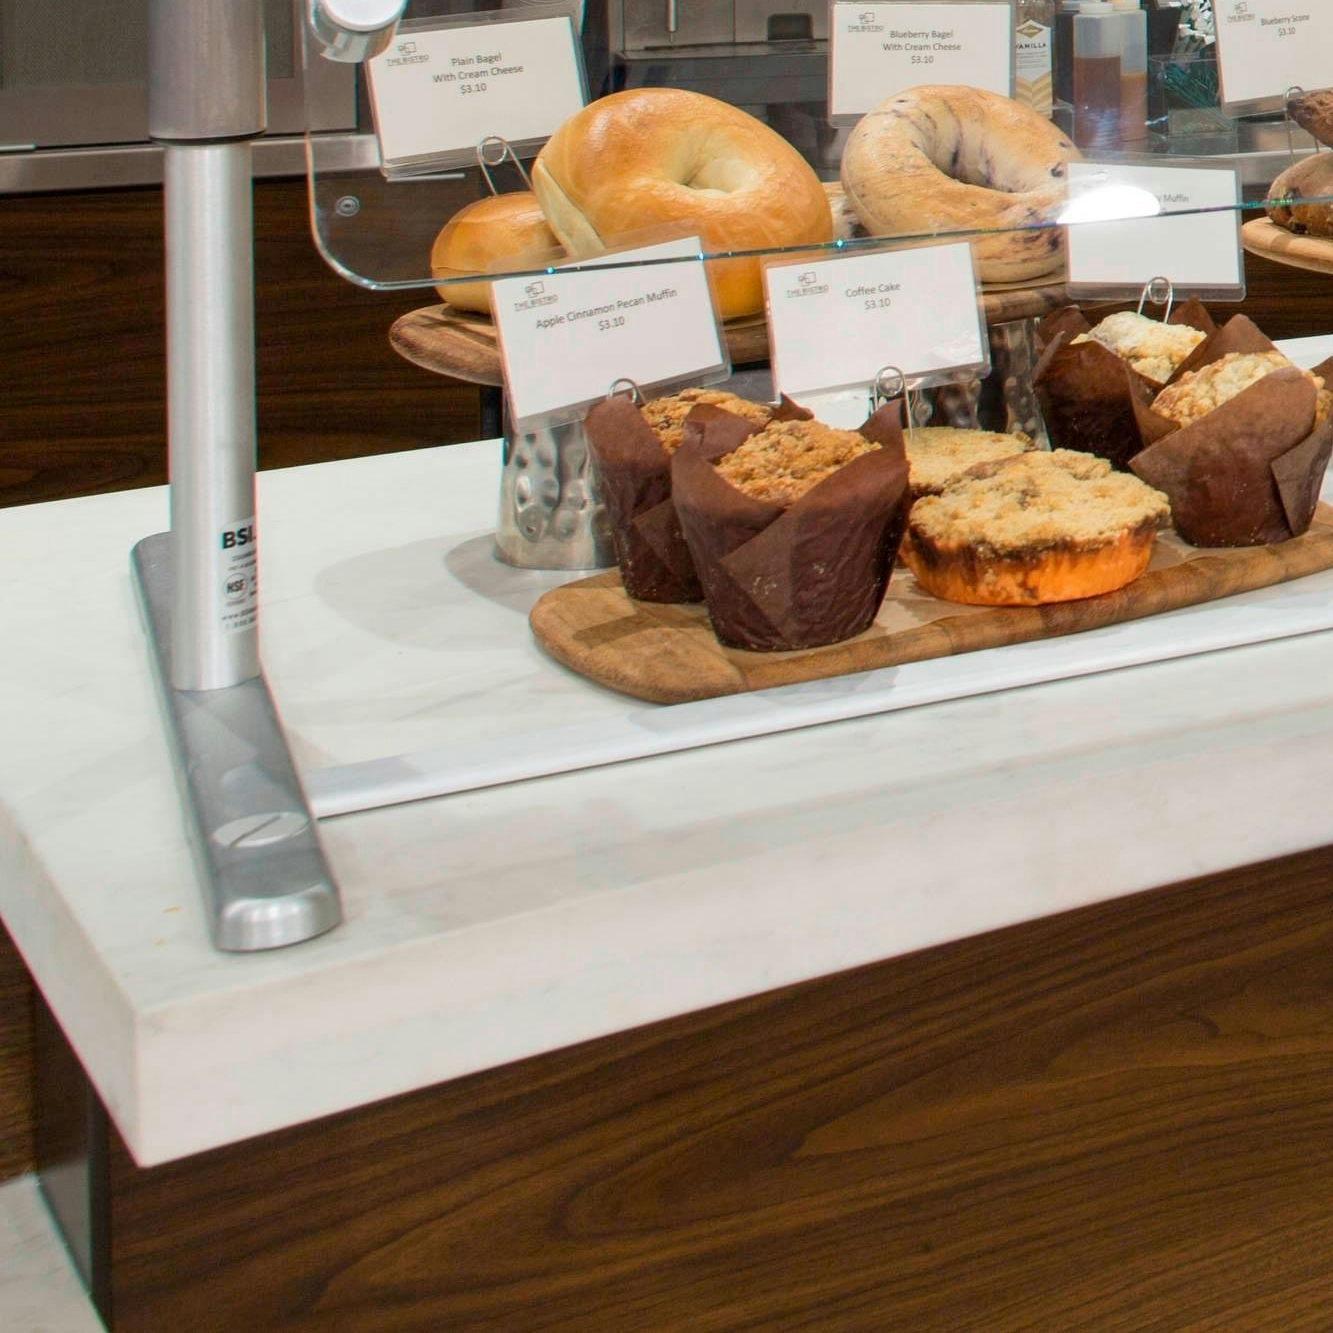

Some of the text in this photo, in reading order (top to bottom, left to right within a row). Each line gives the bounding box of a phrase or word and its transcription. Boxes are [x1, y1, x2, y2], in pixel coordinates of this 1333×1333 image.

[1261, 14, 1309, 26] Blueberry Scone
[890, 30, 953, 39] Blueberry Bagel
[1278, 27, 1296, 36] $3.10
[451, 53, 502, 66] Plain Bagel
[911, 56, 934, 64] $3.10
[433, 66, 523, 82] With Cream Cheese
[460, 83, 487, 94] $3.10
[845, 282, 901, 297] Coffee Cake
[536, 288, 678, 329] Apple Cinnamon Pecan Muffin
[865, 298, 890, 310] $3.10
[599, 316, 625, 331] $3.10
